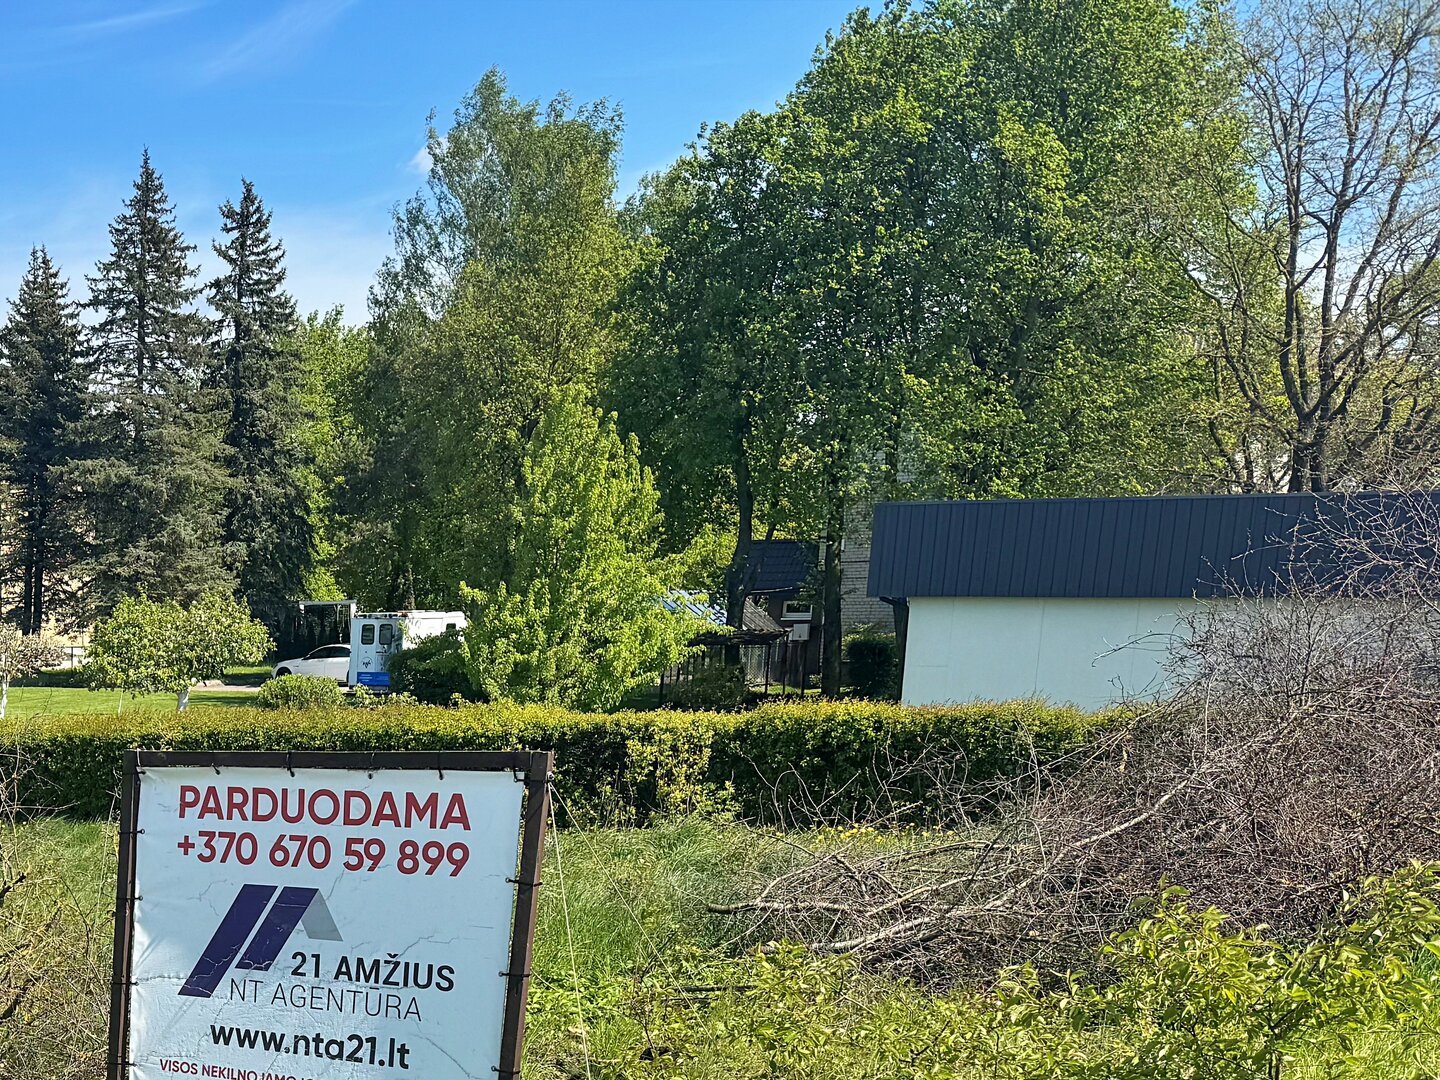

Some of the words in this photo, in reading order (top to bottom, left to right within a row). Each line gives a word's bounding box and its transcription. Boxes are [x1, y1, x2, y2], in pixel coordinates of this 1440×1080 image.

[178, 785, 472, 831] PARDUODAMA
[177, 831, 259, 866] +370
[268, 834, 332, 870] 670
[343, 837, 386, 872] 59
[396, 840, 470, 878] 899
[291, 951, 321, 979] 21
[333, 952, 455, 992] AMŽIUS
[229, 977, 265, 1004] NT
[270, 982, 422, 1022] AGENTŪRA
[160, 1059, 199, 1076] VISOS
[210, 1024, 410, 1070] www.nta21.lt
